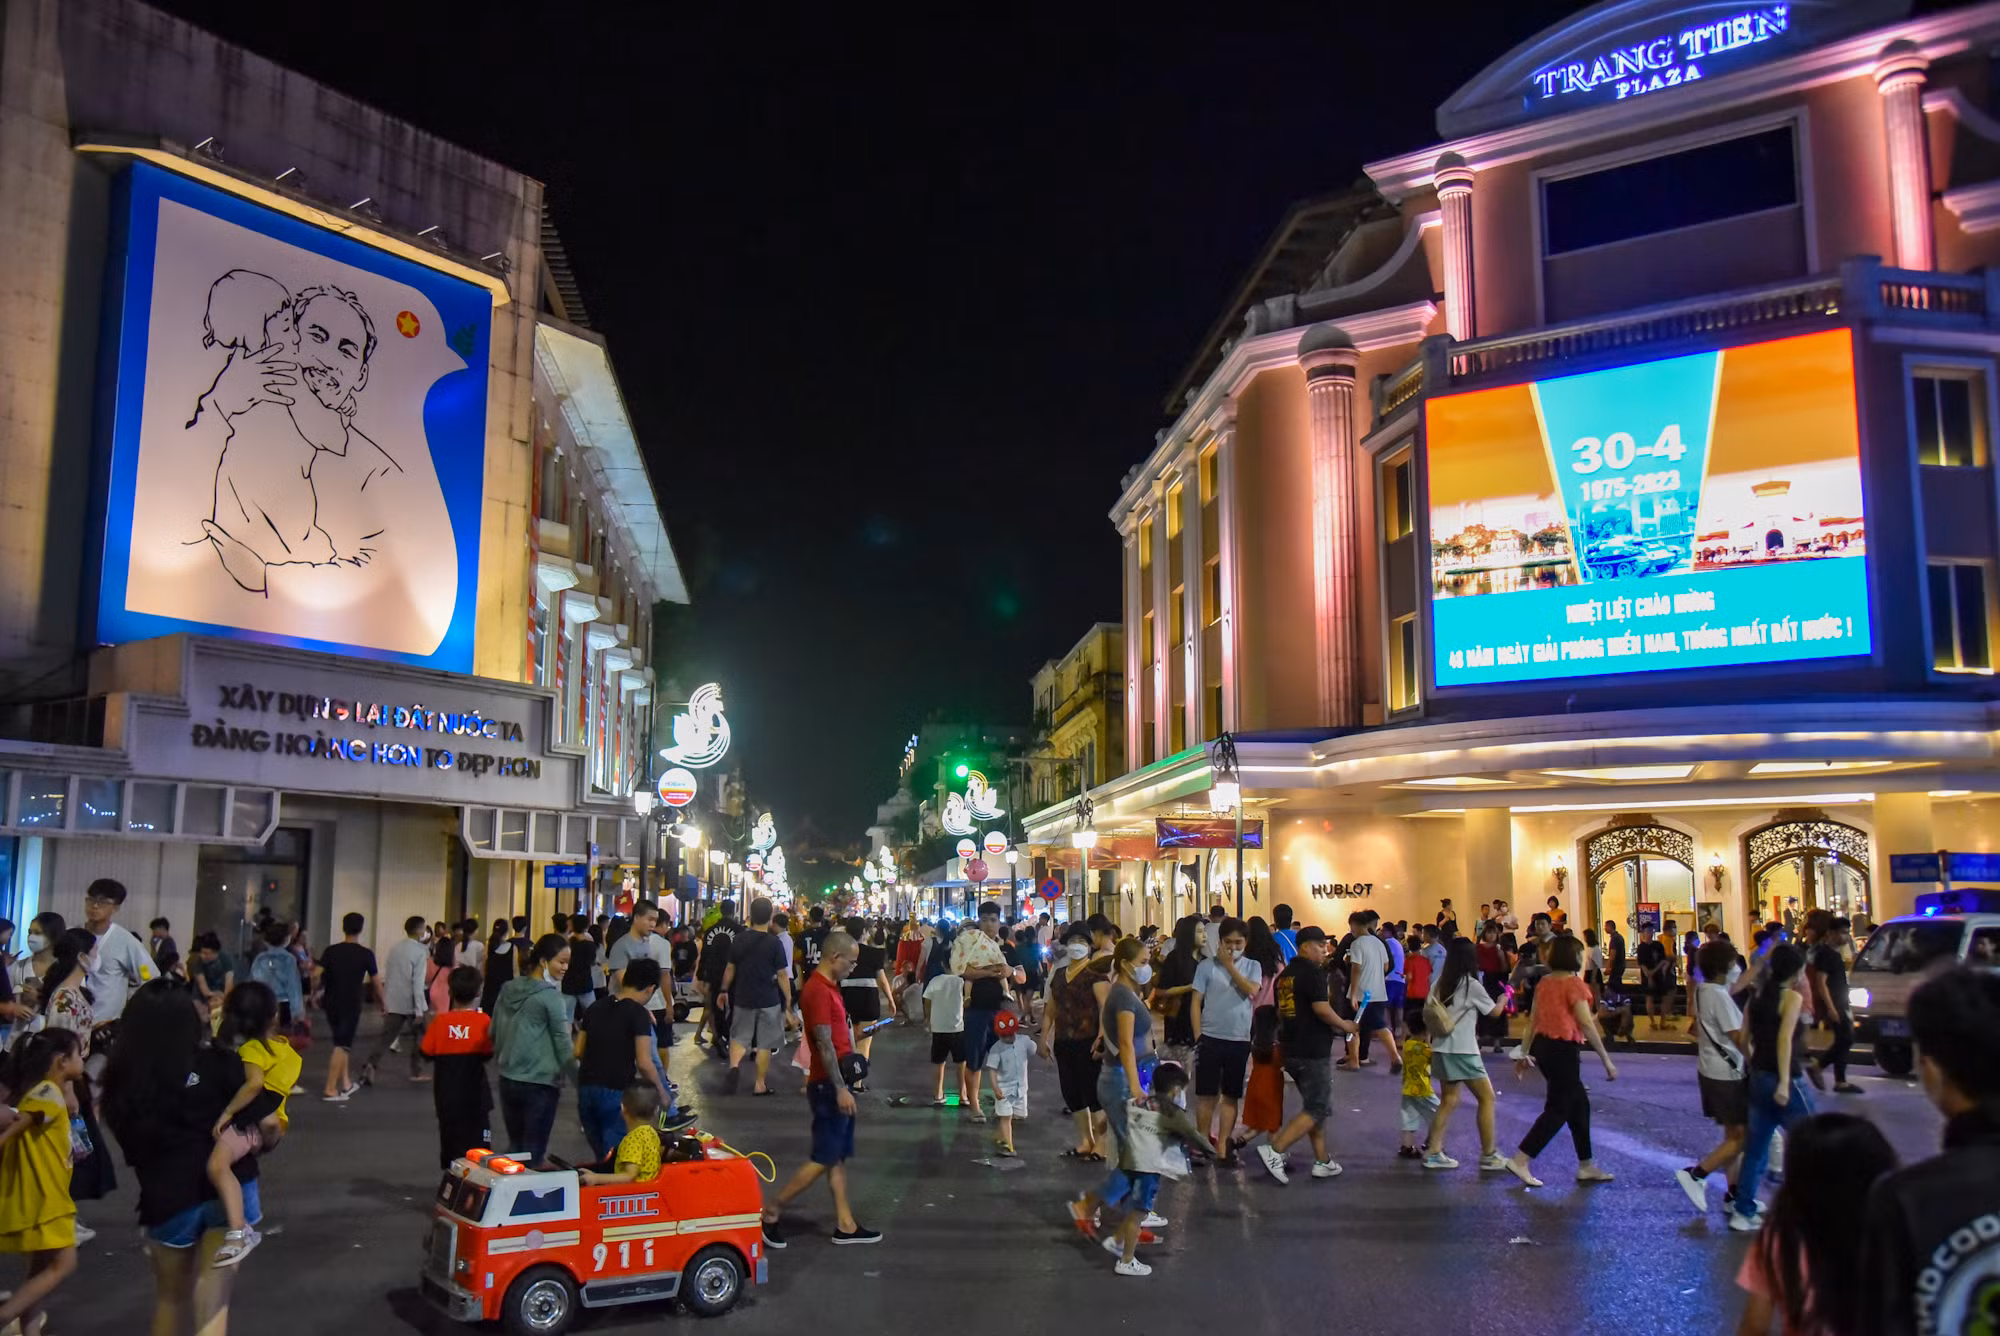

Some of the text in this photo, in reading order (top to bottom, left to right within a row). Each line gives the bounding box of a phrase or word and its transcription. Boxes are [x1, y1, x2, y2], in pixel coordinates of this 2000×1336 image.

[1533, 36, 1675, 98] TRANG
[1616, 64, 1702, 100] PLAZA
[1572, 424, 1686, 474] 30-4
[1581, 470, 1680, 502] 1975-2023
[1606, 596, 1632, 623] LIỆT
[219, 683, 524, 743] XÂY DỰNG LẠI ĐẤT NƯỚC TA
[191, 718, 271, 752] ĐÀNG
[275, 730, 368, 761] HOÀNG
[426, 748, 454, 770] TO
[457, 752, 495, 778] ĐẸP
[1312, 883, 1373, 897] HUBLOT
[1639, 905, 1656, 913] SALE
[805, 937, 821, 964] LA
